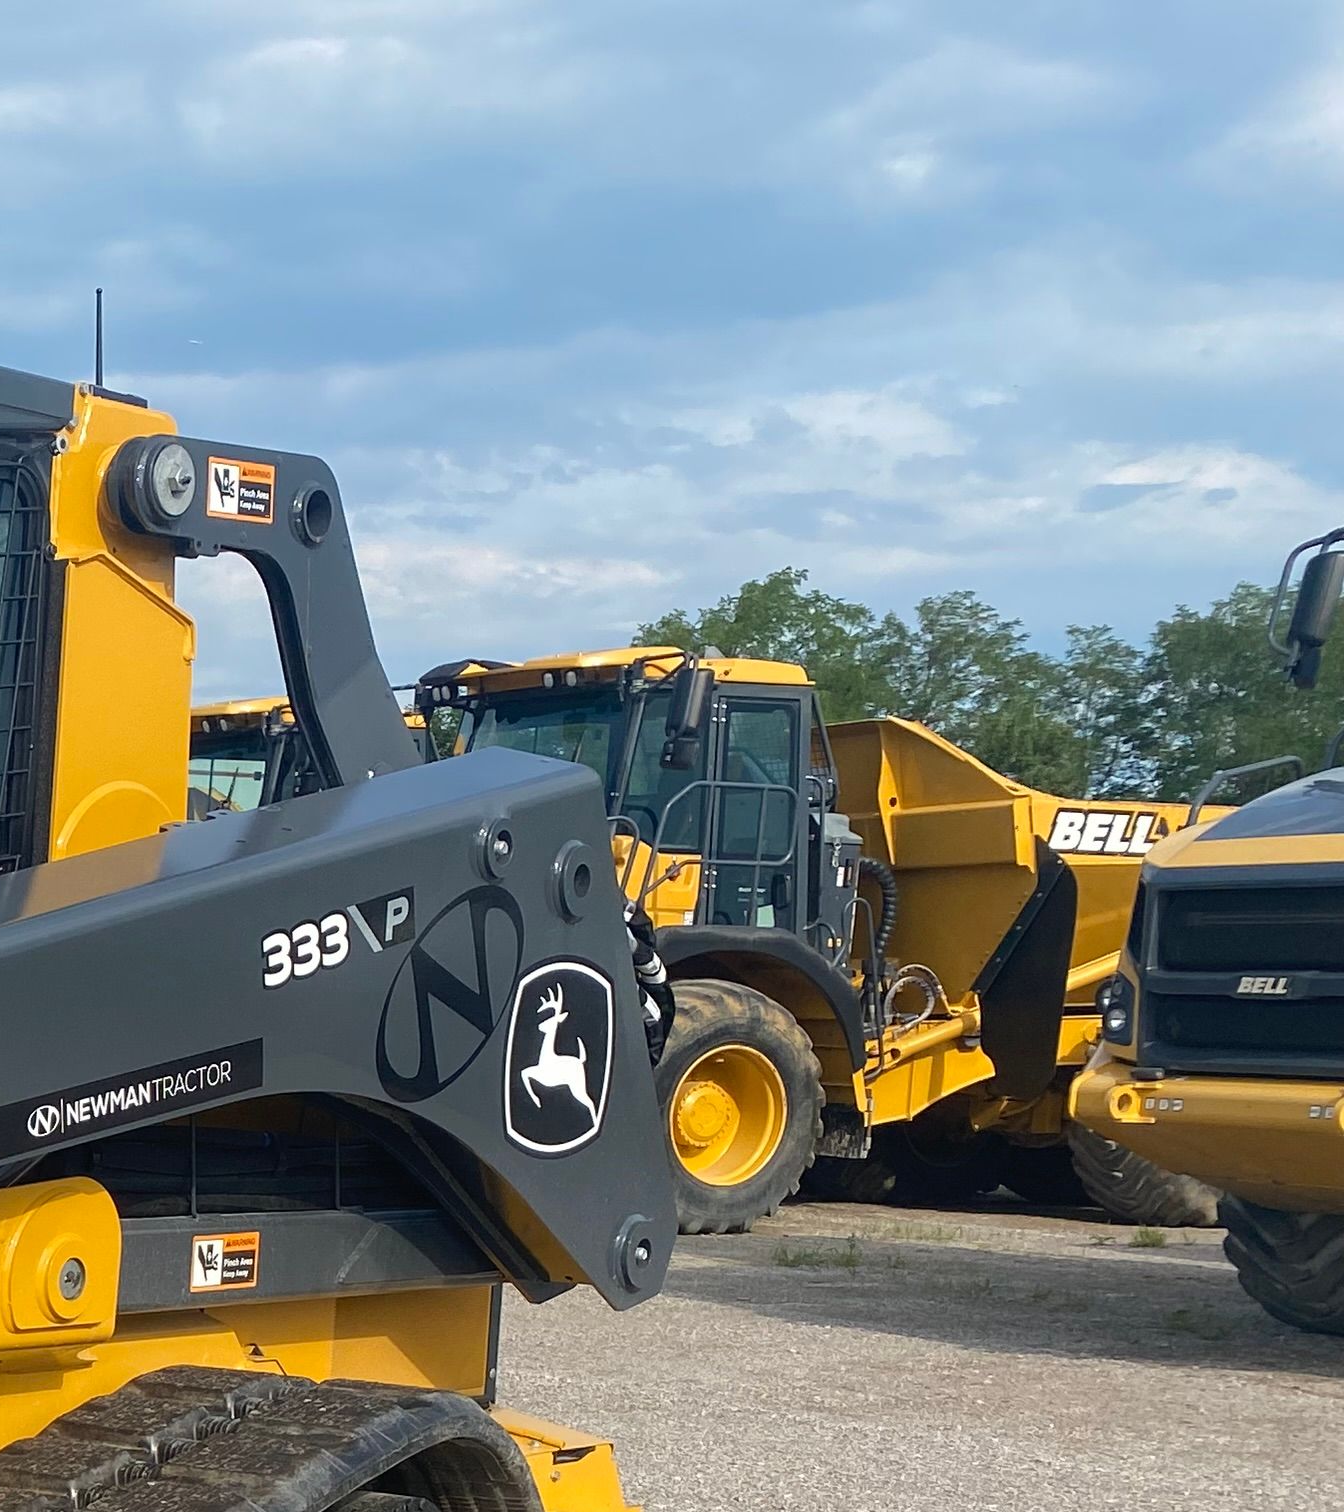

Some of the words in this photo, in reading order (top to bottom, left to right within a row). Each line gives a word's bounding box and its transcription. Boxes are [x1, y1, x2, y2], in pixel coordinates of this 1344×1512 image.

[1048, 810, 1155, 854] BELL
[261, 913, 349, 987] 333
[1236, 976, 1288, 994] BELL
